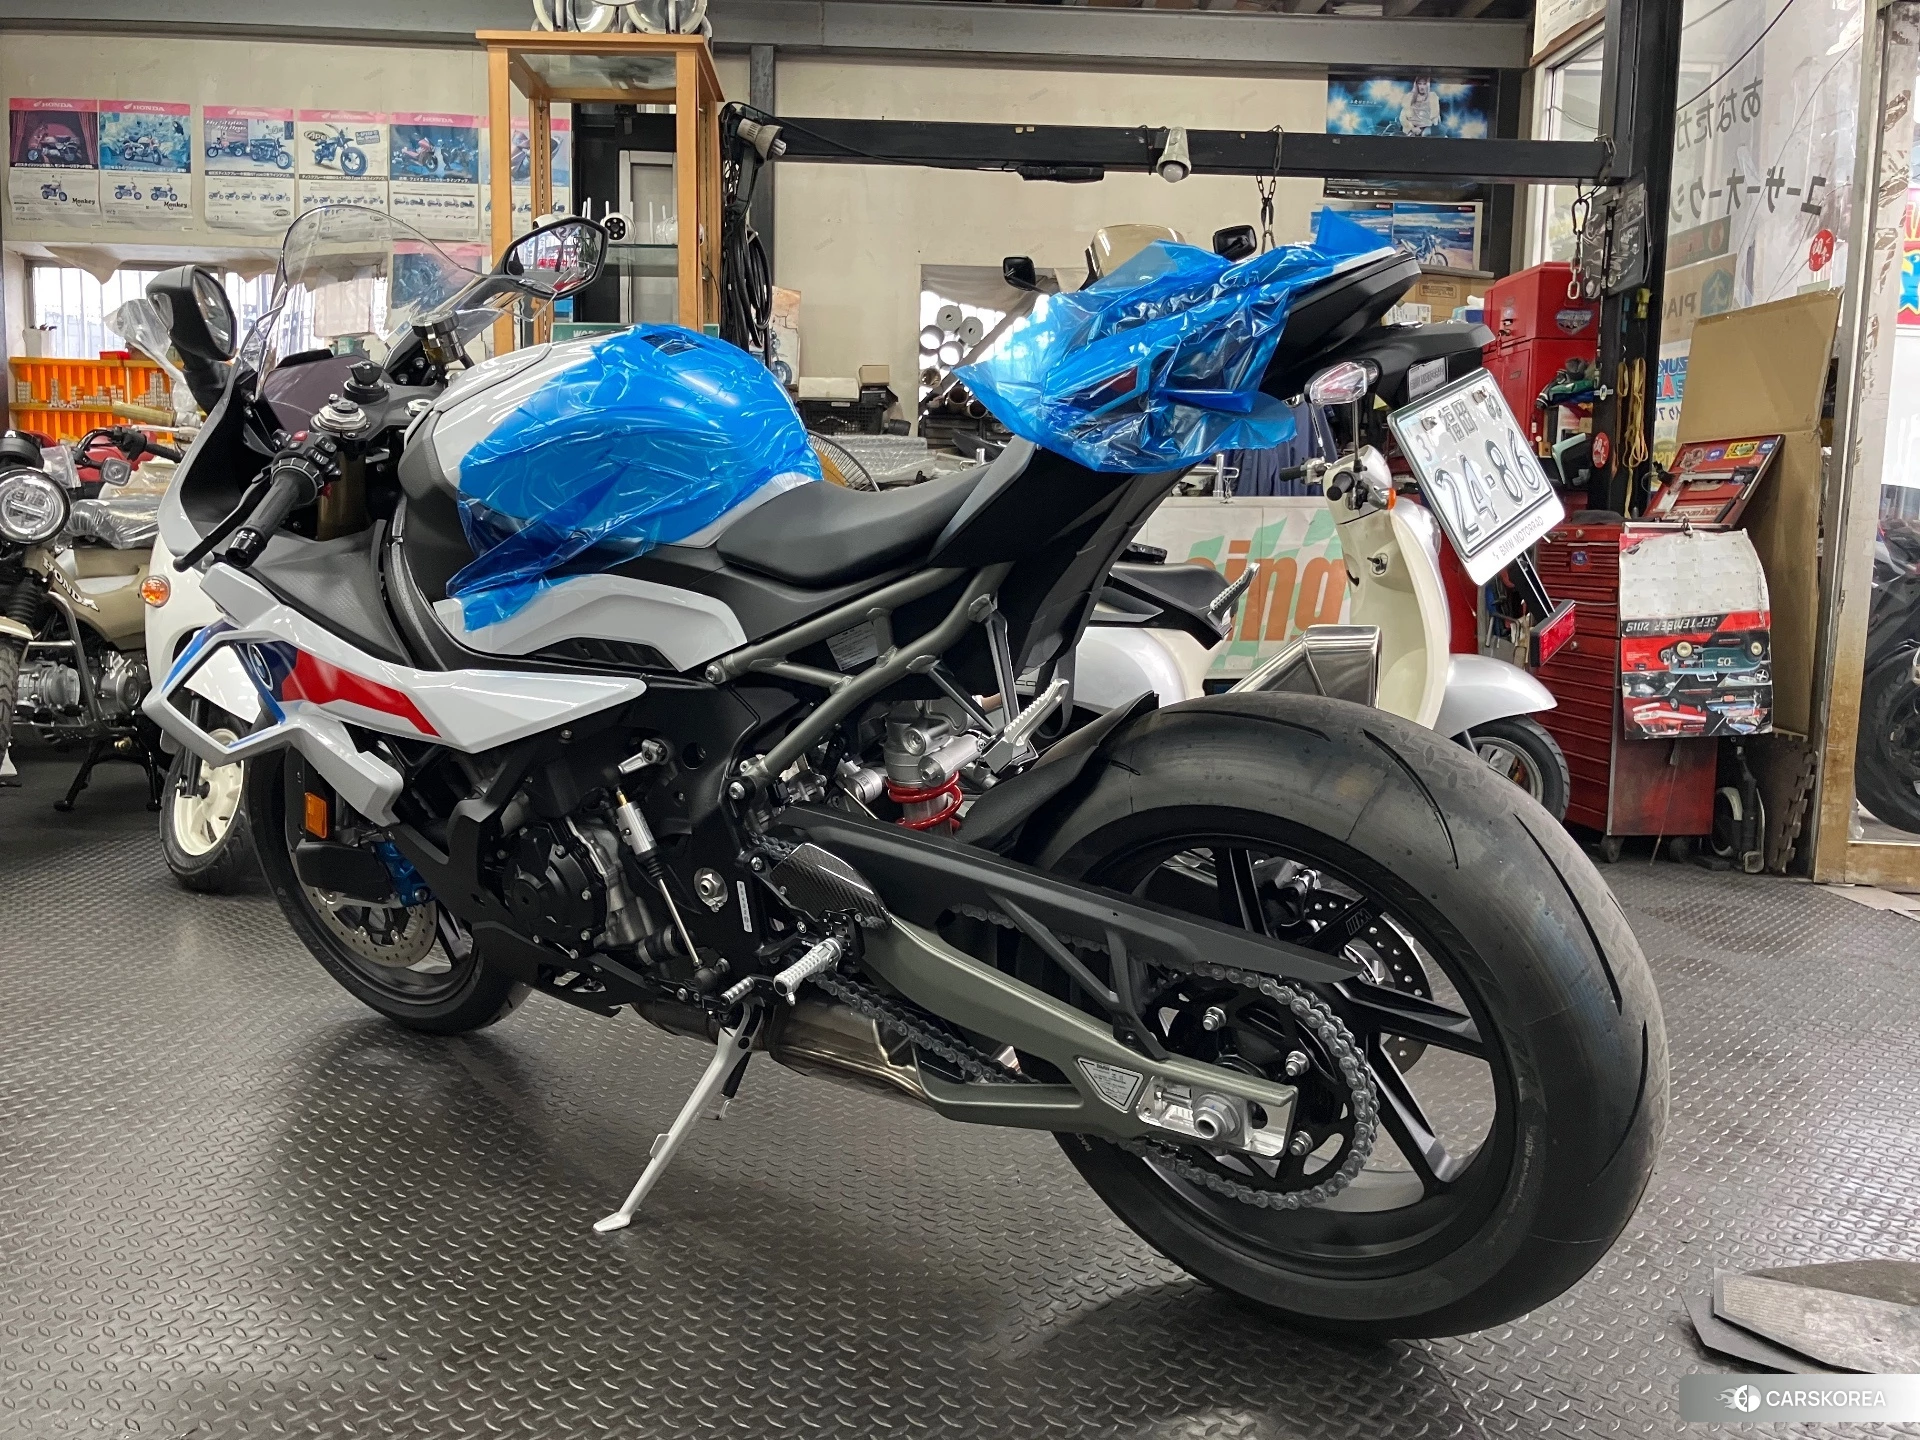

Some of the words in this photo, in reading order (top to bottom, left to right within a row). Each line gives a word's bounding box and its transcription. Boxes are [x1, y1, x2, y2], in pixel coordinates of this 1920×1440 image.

[72, 198, 95, 207] Monkey
[164, 201, 187, 210] Monkey
[1439, 398, 1477, 443] 福岡
[1498, 539, 1515, 561] BMW
[1513, 515, 1545, 548] MOTORRAD
[42, 557, 100, 612] HONDA
[1625, 621, 1650, 632] 2019
[1653, 616, 1718, 632] SEPTEMBER
